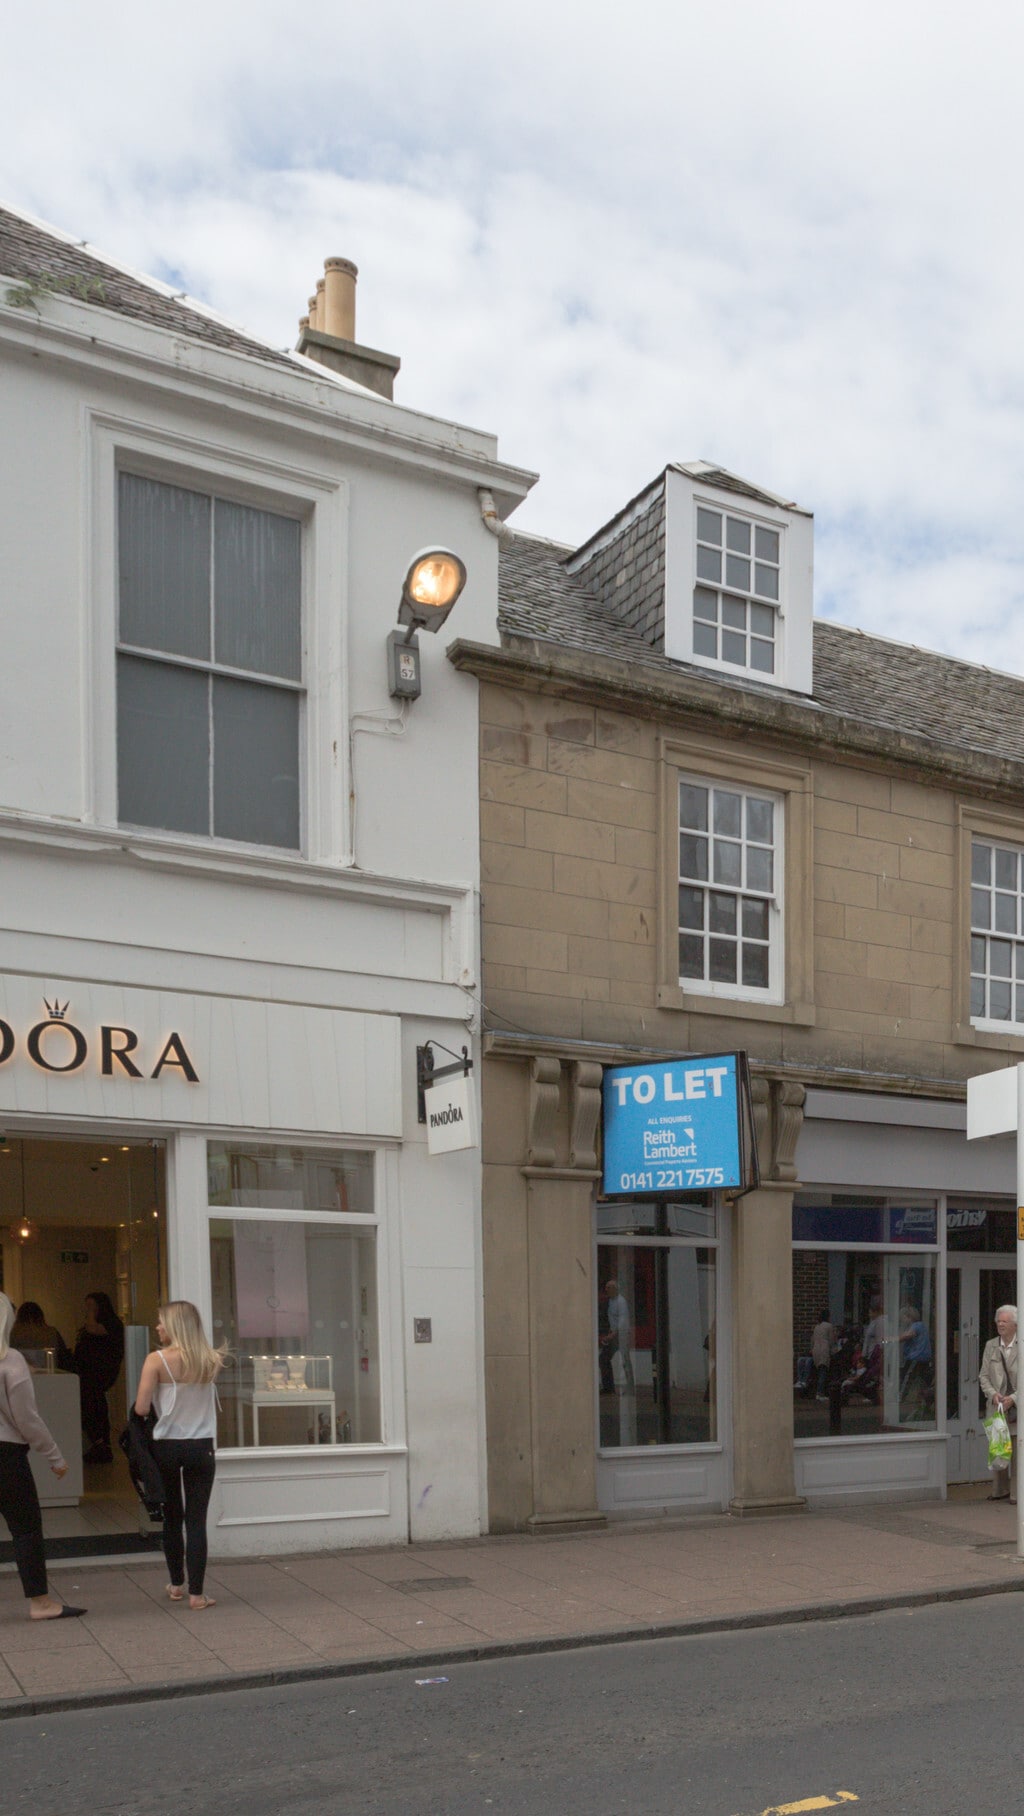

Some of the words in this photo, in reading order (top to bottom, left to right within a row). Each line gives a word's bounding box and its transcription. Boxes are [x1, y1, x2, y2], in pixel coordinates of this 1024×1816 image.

[401, 668, 414, 679] 57
[612, 1074, 656, 1106] TO
[663, 1067, 728, 1102] LET
[430, 1106, 464, 1128] PANDORA
[647, 1117, 659, 1125] ALL
[643, 1130, 676, 1145] Reith
[644, 1141, 697, 1159] Lambert
[620, 1171, 653, 1190] 0141
[657, 1169, 683, 1188] 221
[685, 1167, 724, 1186] 7575
